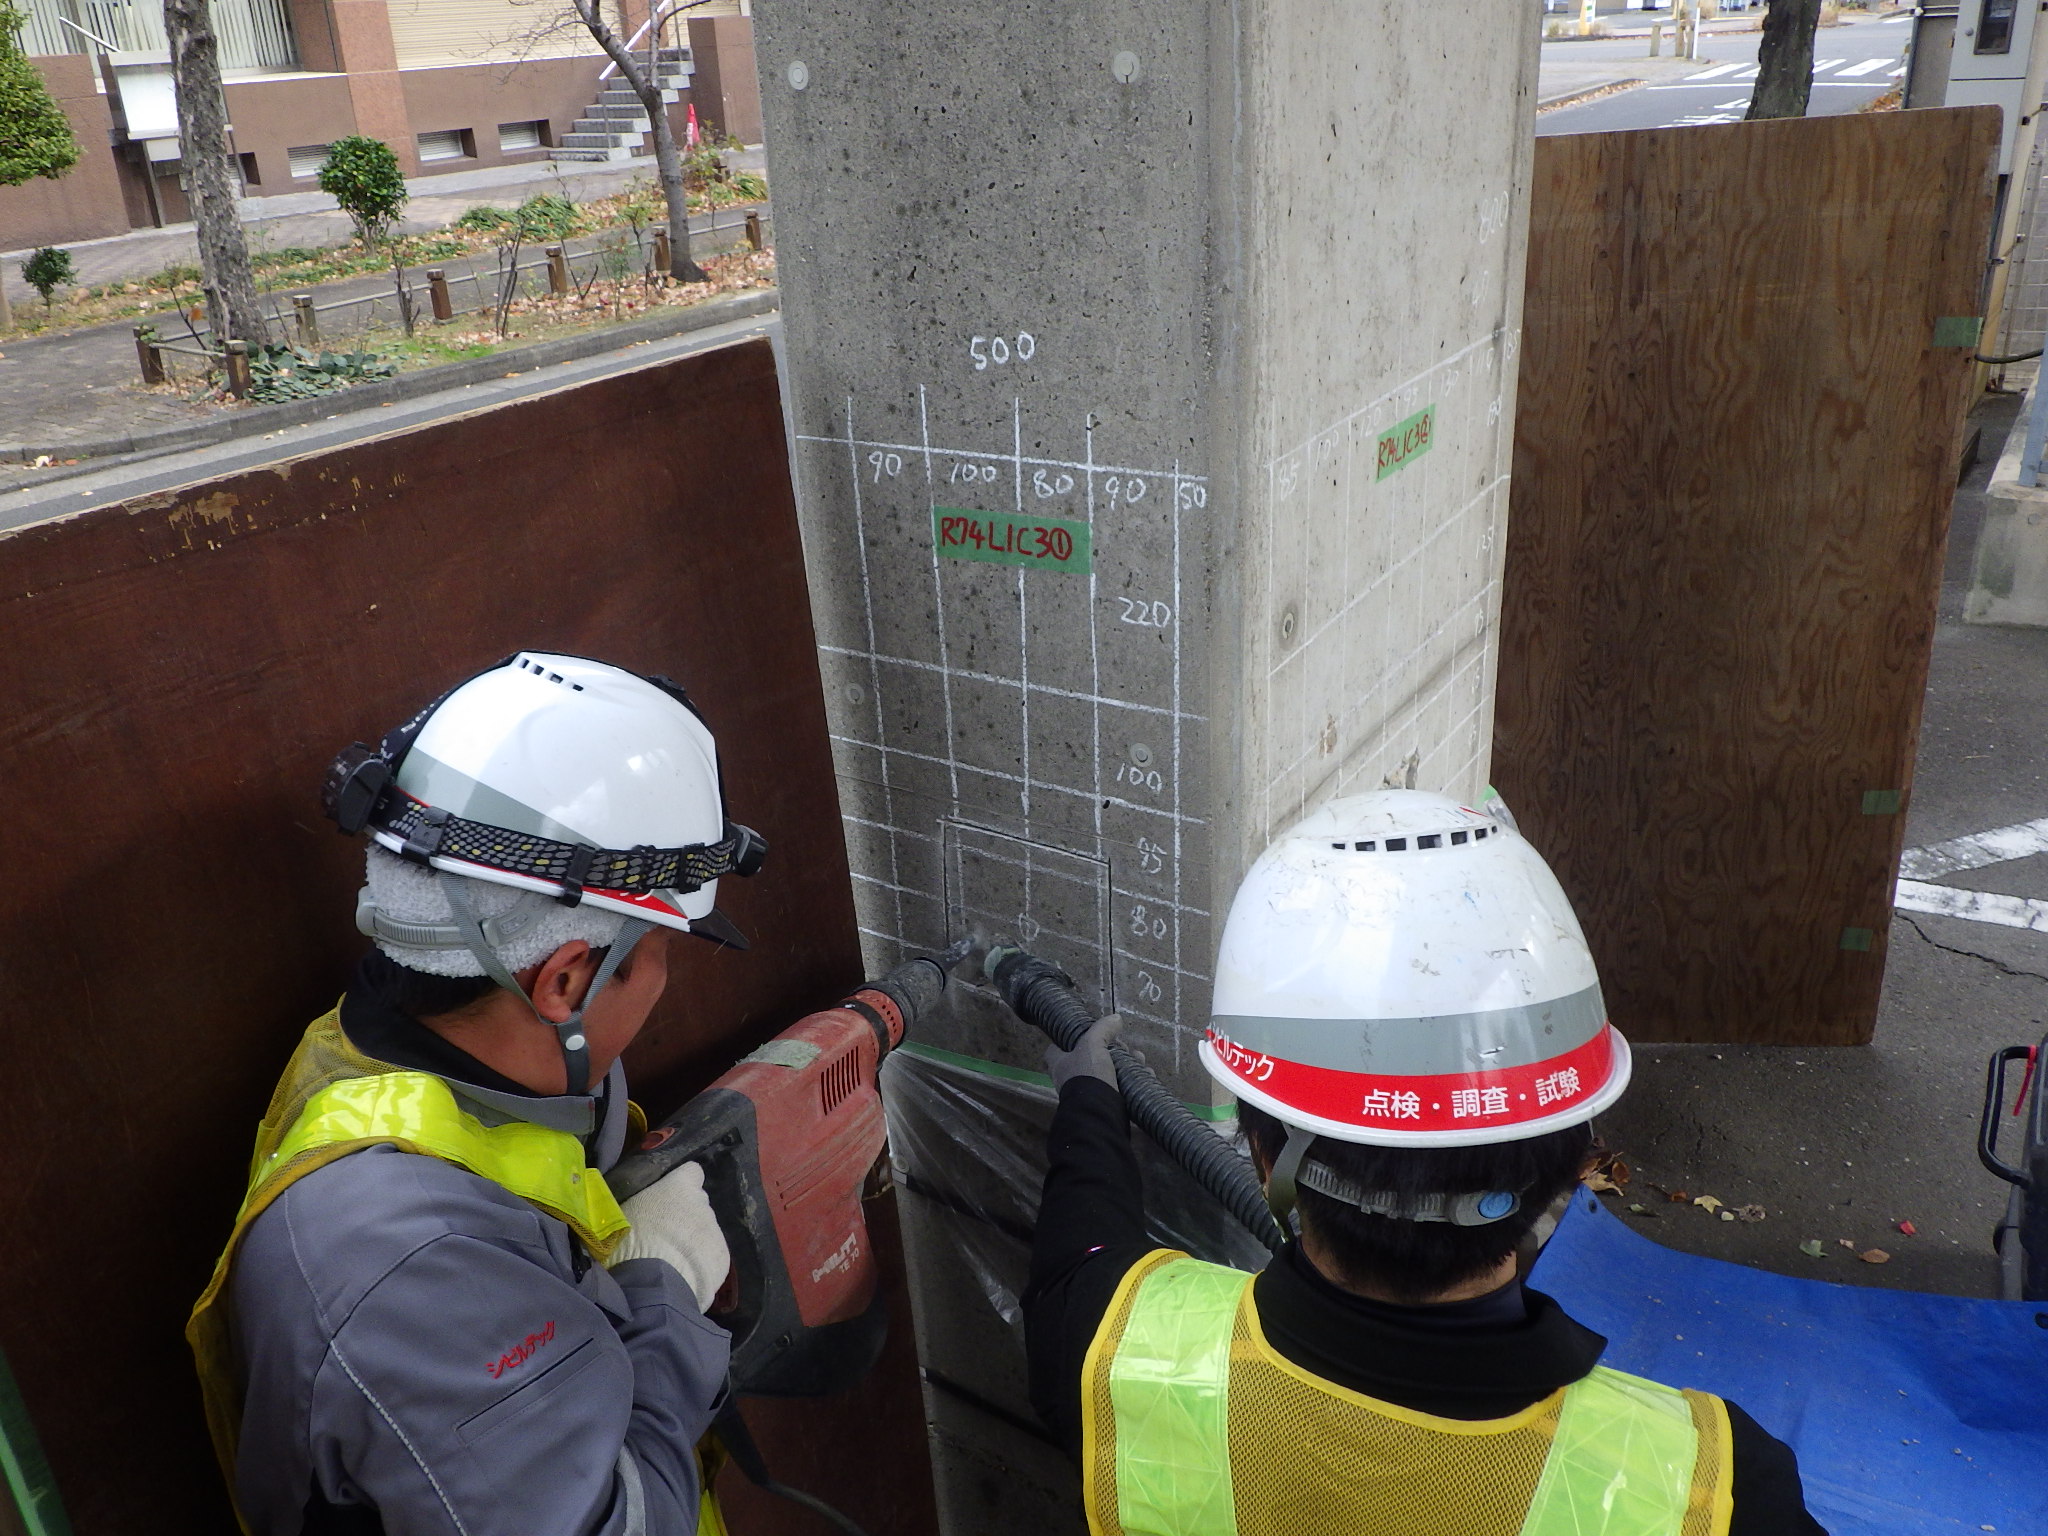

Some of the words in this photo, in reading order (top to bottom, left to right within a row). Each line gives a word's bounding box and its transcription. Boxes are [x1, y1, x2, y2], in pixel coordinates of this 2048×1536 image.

[969, 330, 1036, 371] 500
[1359, 406, 1382, 438] 120
[869, 453, 901, 483] 90
[949, 463, 997, 483] 100
[1033, 469, 1074, 498] 80
[1105, 477, 1146, 509] 90
[1178, 482, 1207, 510] 50
[1118, 597, 1171, 627] 220
[1116, 763, 1163, 794] 100
[1130, 904, 1167, 940] 80
[1137, 970, 1162, 1002] 70
[1361, 1066, 1582, 1120] 点検・調査・試験
